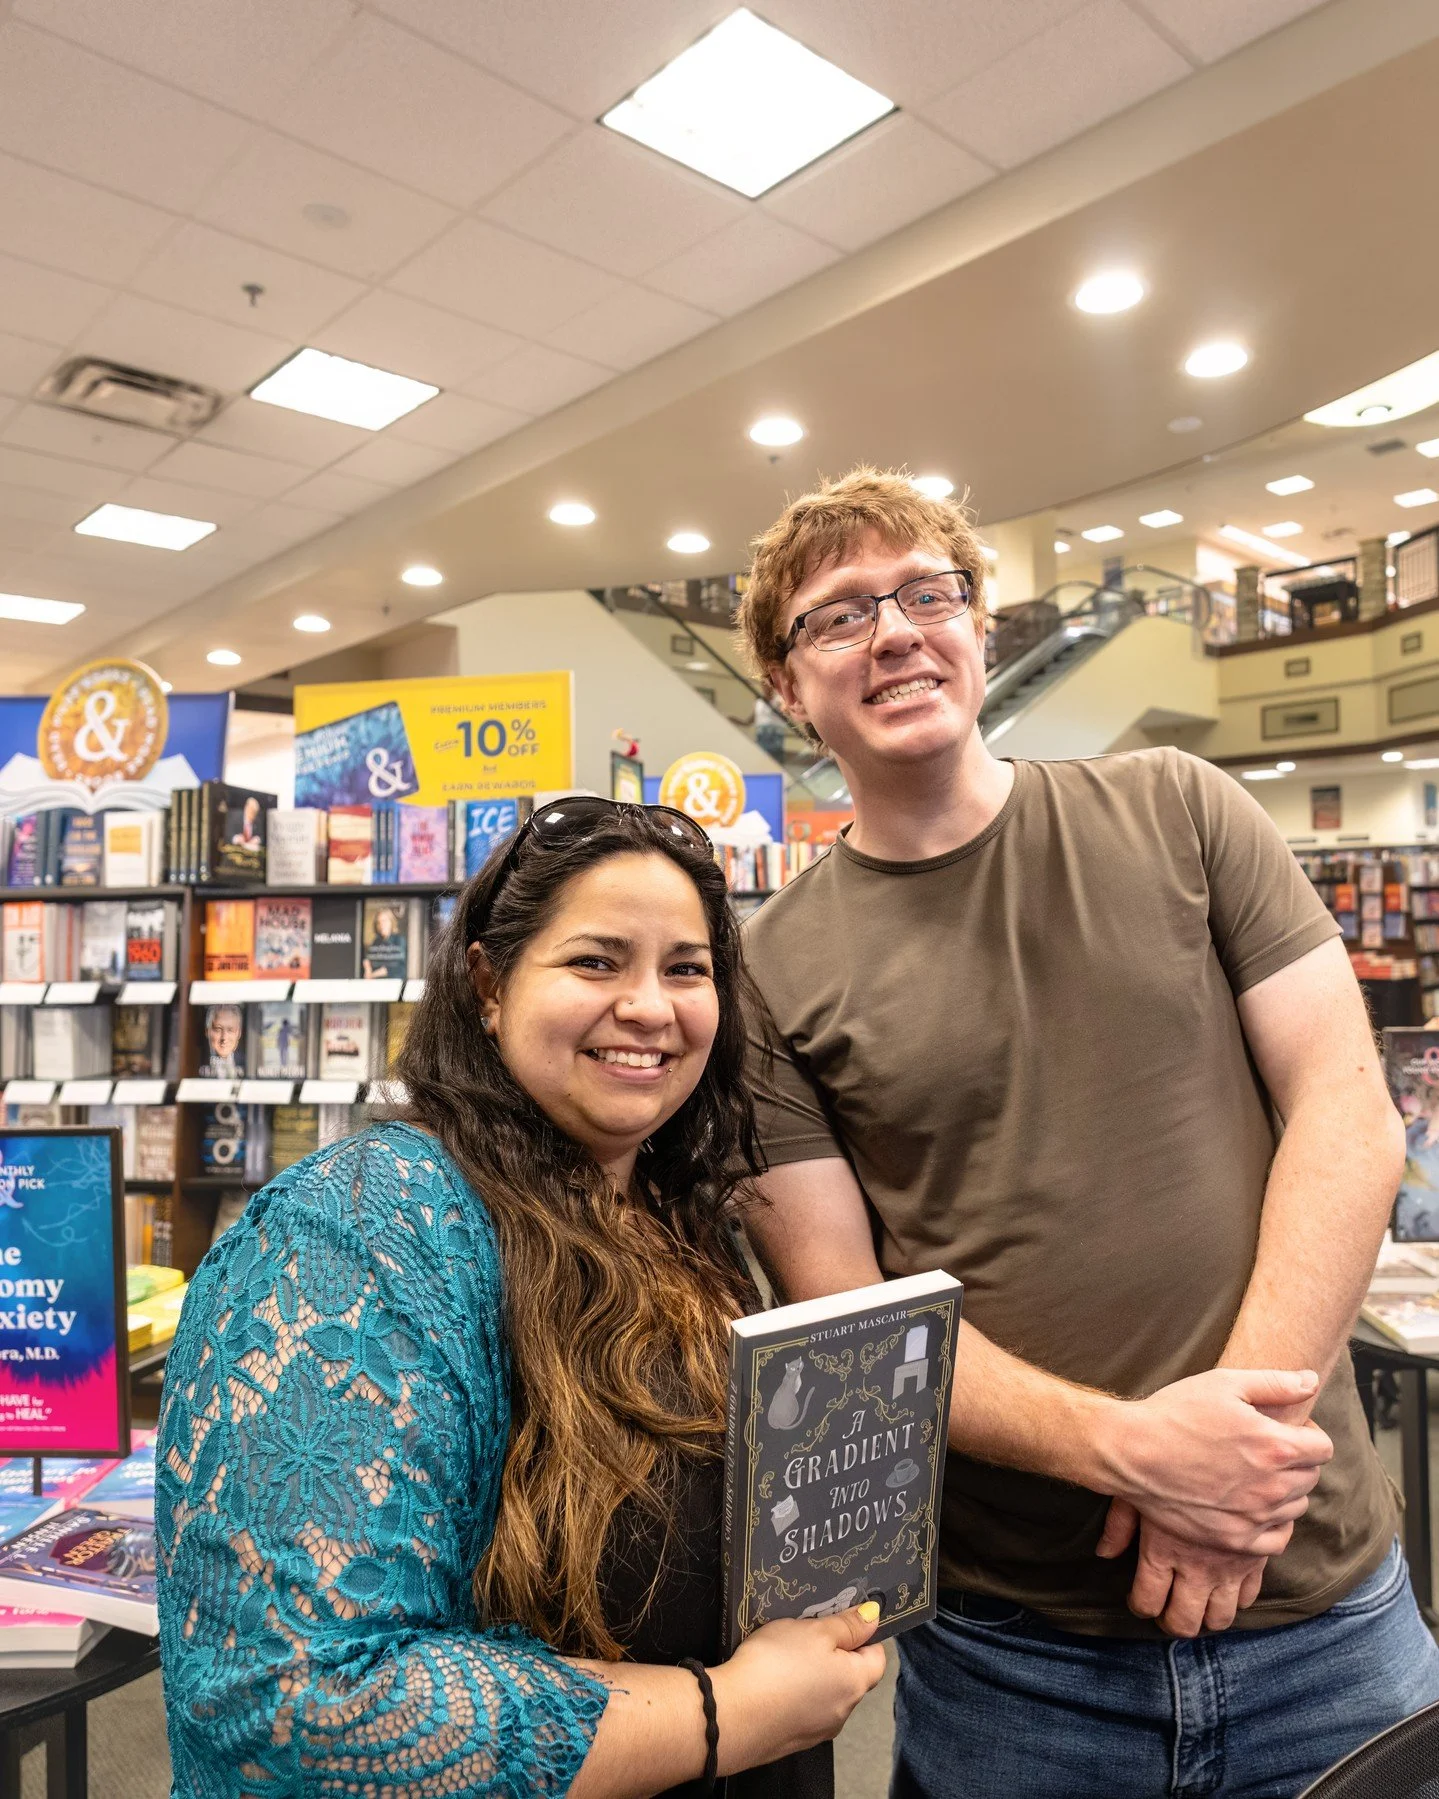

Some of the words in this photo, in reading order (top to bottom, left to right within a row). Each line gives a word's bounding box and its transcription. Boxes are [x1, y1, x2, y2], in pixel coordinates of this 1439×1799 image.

[489, 699, 546, 711] MEMBERS
[507, 743, 541, 757] OFF
[467, 805, 513, 838] ICE
[18, 1178, 46, 1189] PICK
[810, 1323, 855, 1343] STUART
[858, 1310, 907, 1331] MASCAIR
[25, 1347, 60, 1360] M.D.
[728, 1393, 738, 1454] GRADIENT
[842, 1409, 866, 1439] A
[783, 1423, 915, 1489] GRADIENT
[829, 1478, 870, 1509] INTO
[725, 1483, 735, 1543] SHADOWS
[779, 1490, 907, 1563] SHADOWS
